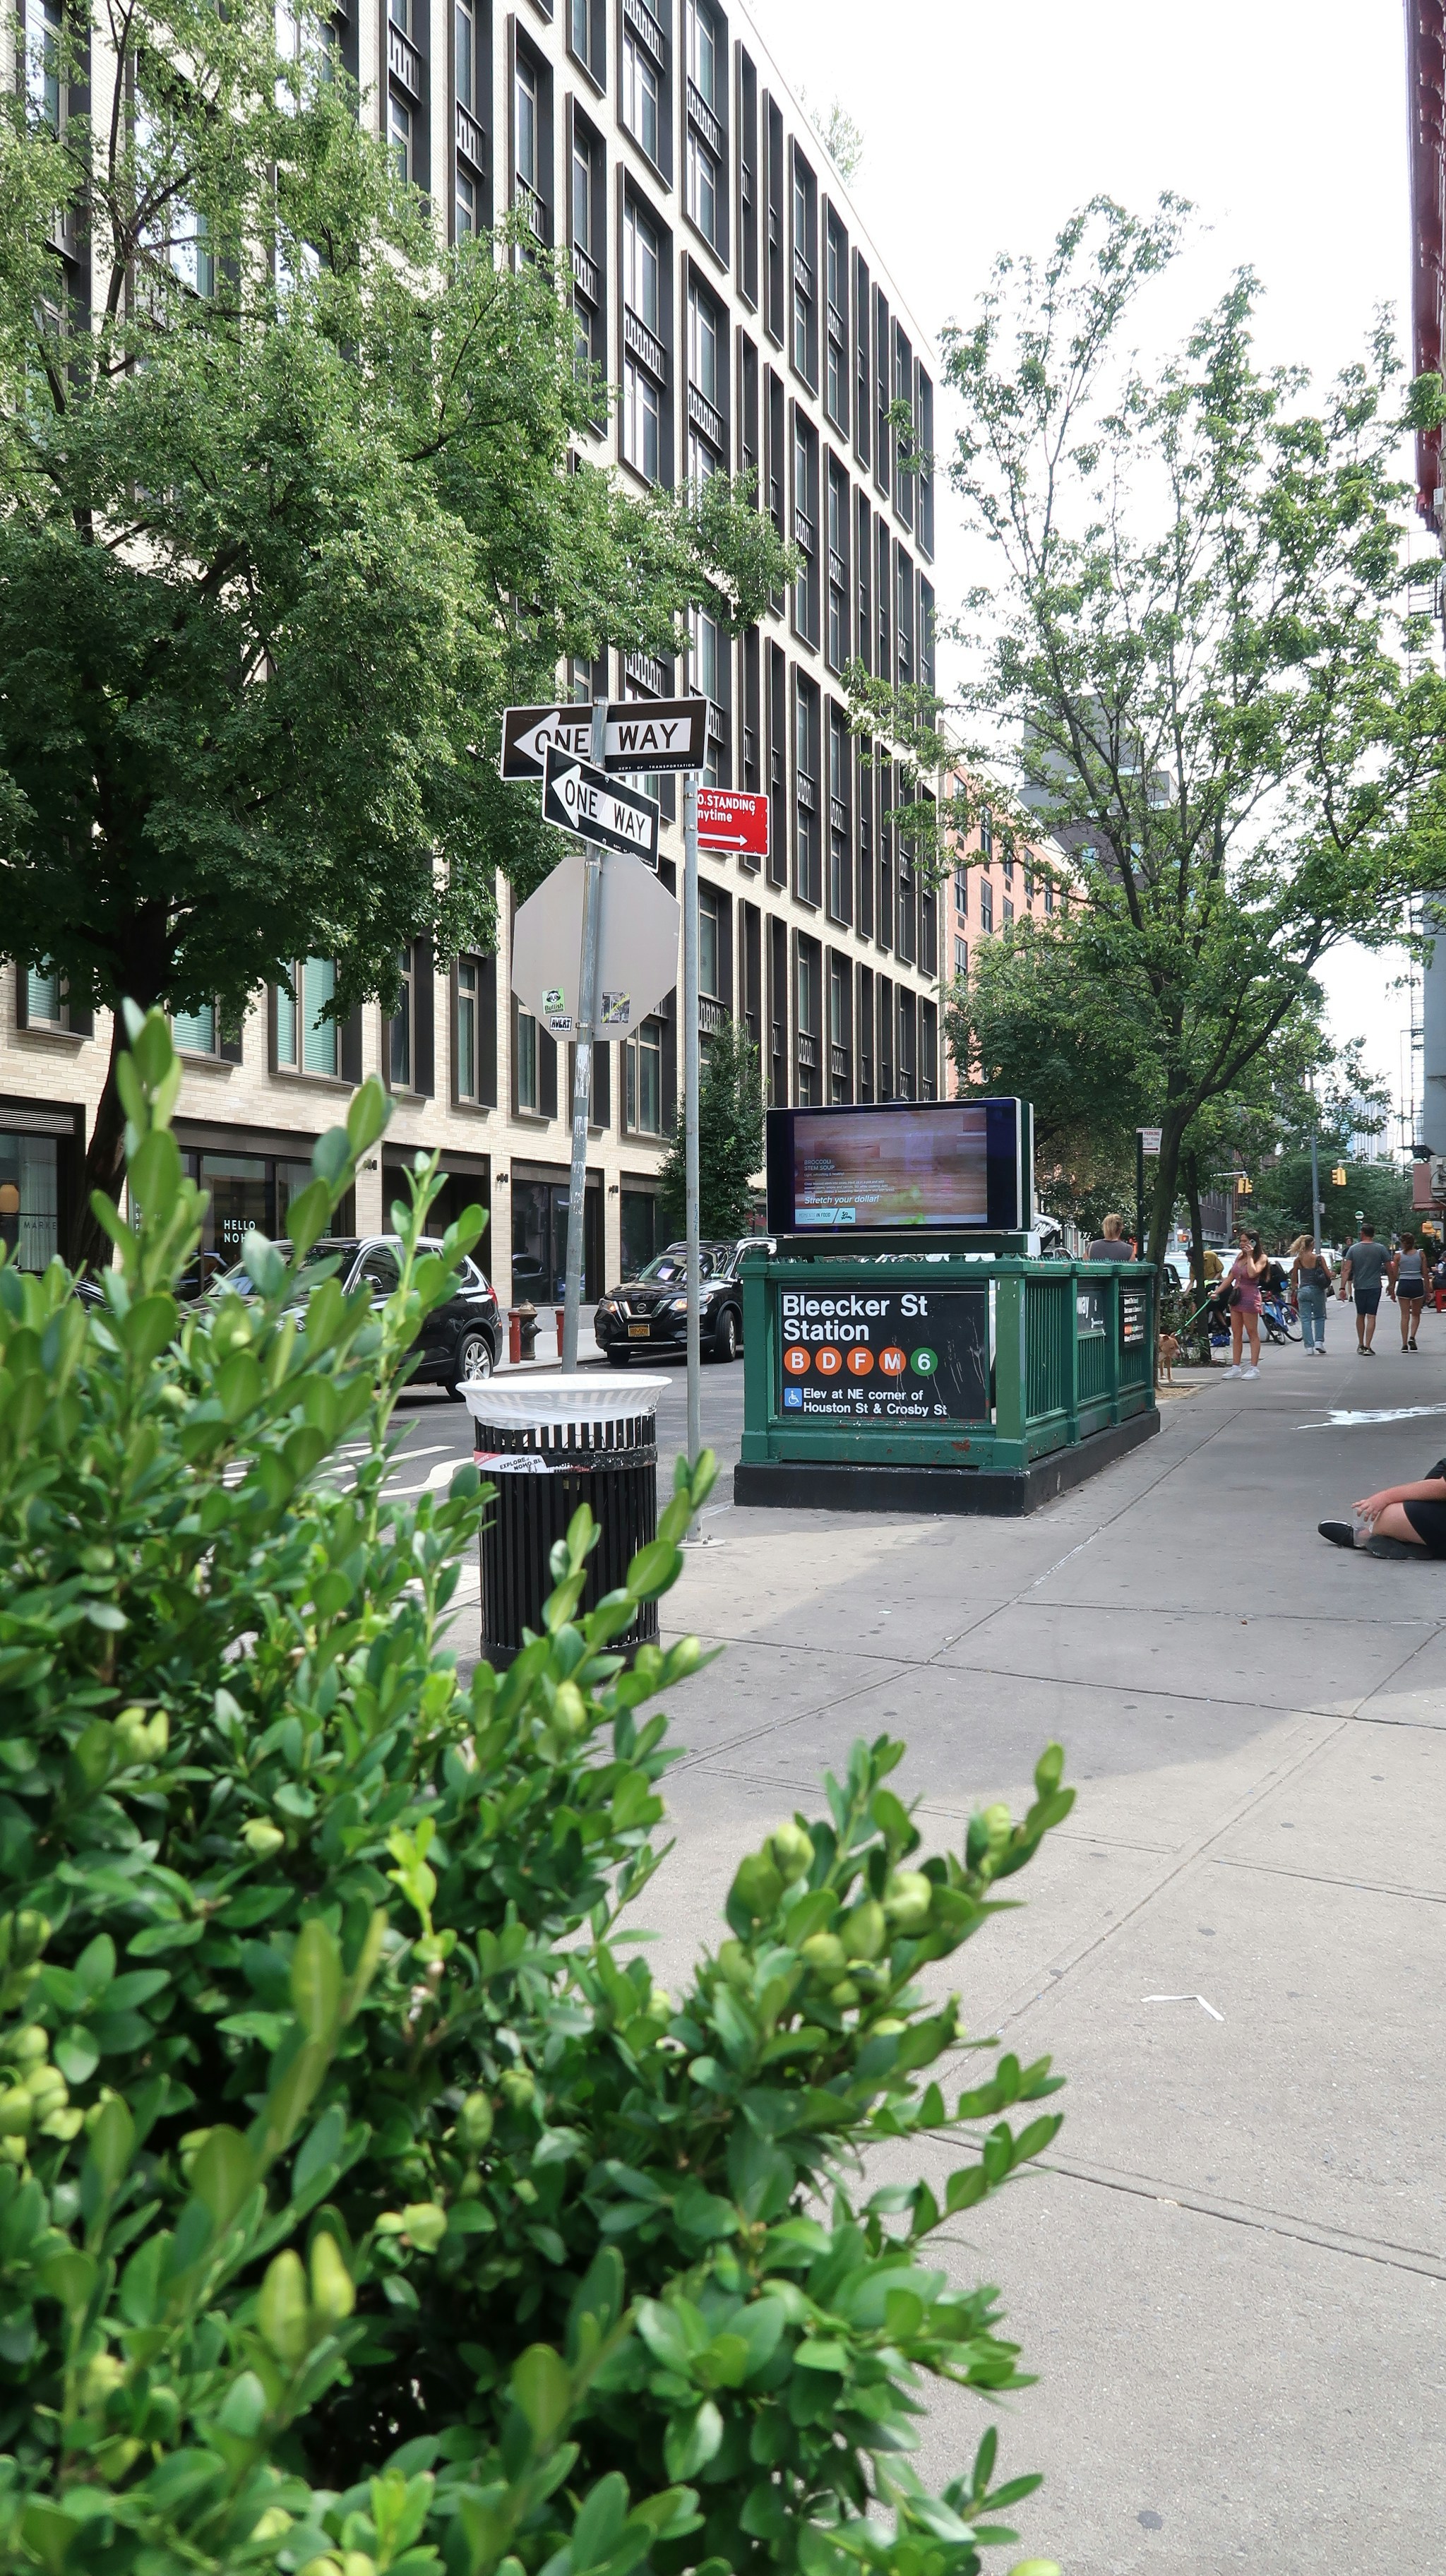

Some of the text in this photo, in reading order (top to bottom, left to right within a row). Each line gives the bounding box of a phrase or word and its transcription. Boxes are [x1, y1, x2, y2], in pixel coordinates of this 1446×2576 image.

[534, 722, 679, 755] ONE WAY
[565, 779, 645, 841] ONE WAY
[707, 794, 755, 812] STANDING
[698, 809, 733, 823] nytime
[544, 1003, 563, 1011] Bullish
[551, 1019, 570, 1028] AVERT
[804, 1195, 880, 1205] Stretch your dollar!
[224, 1220, 256, 1231] HELLO
[782, 1294, 928, 1317] Bleecker St
[783, 1318, 869, 1341] Station
[791, 1352, 931, 1370] B D F M 6
[803, 1388, 924, 1401] Elev at NE corner of
[803, 1402, 948, 1417] Houston St & Crosby St
[499, 1457, 526, 1469] EXPLORE
